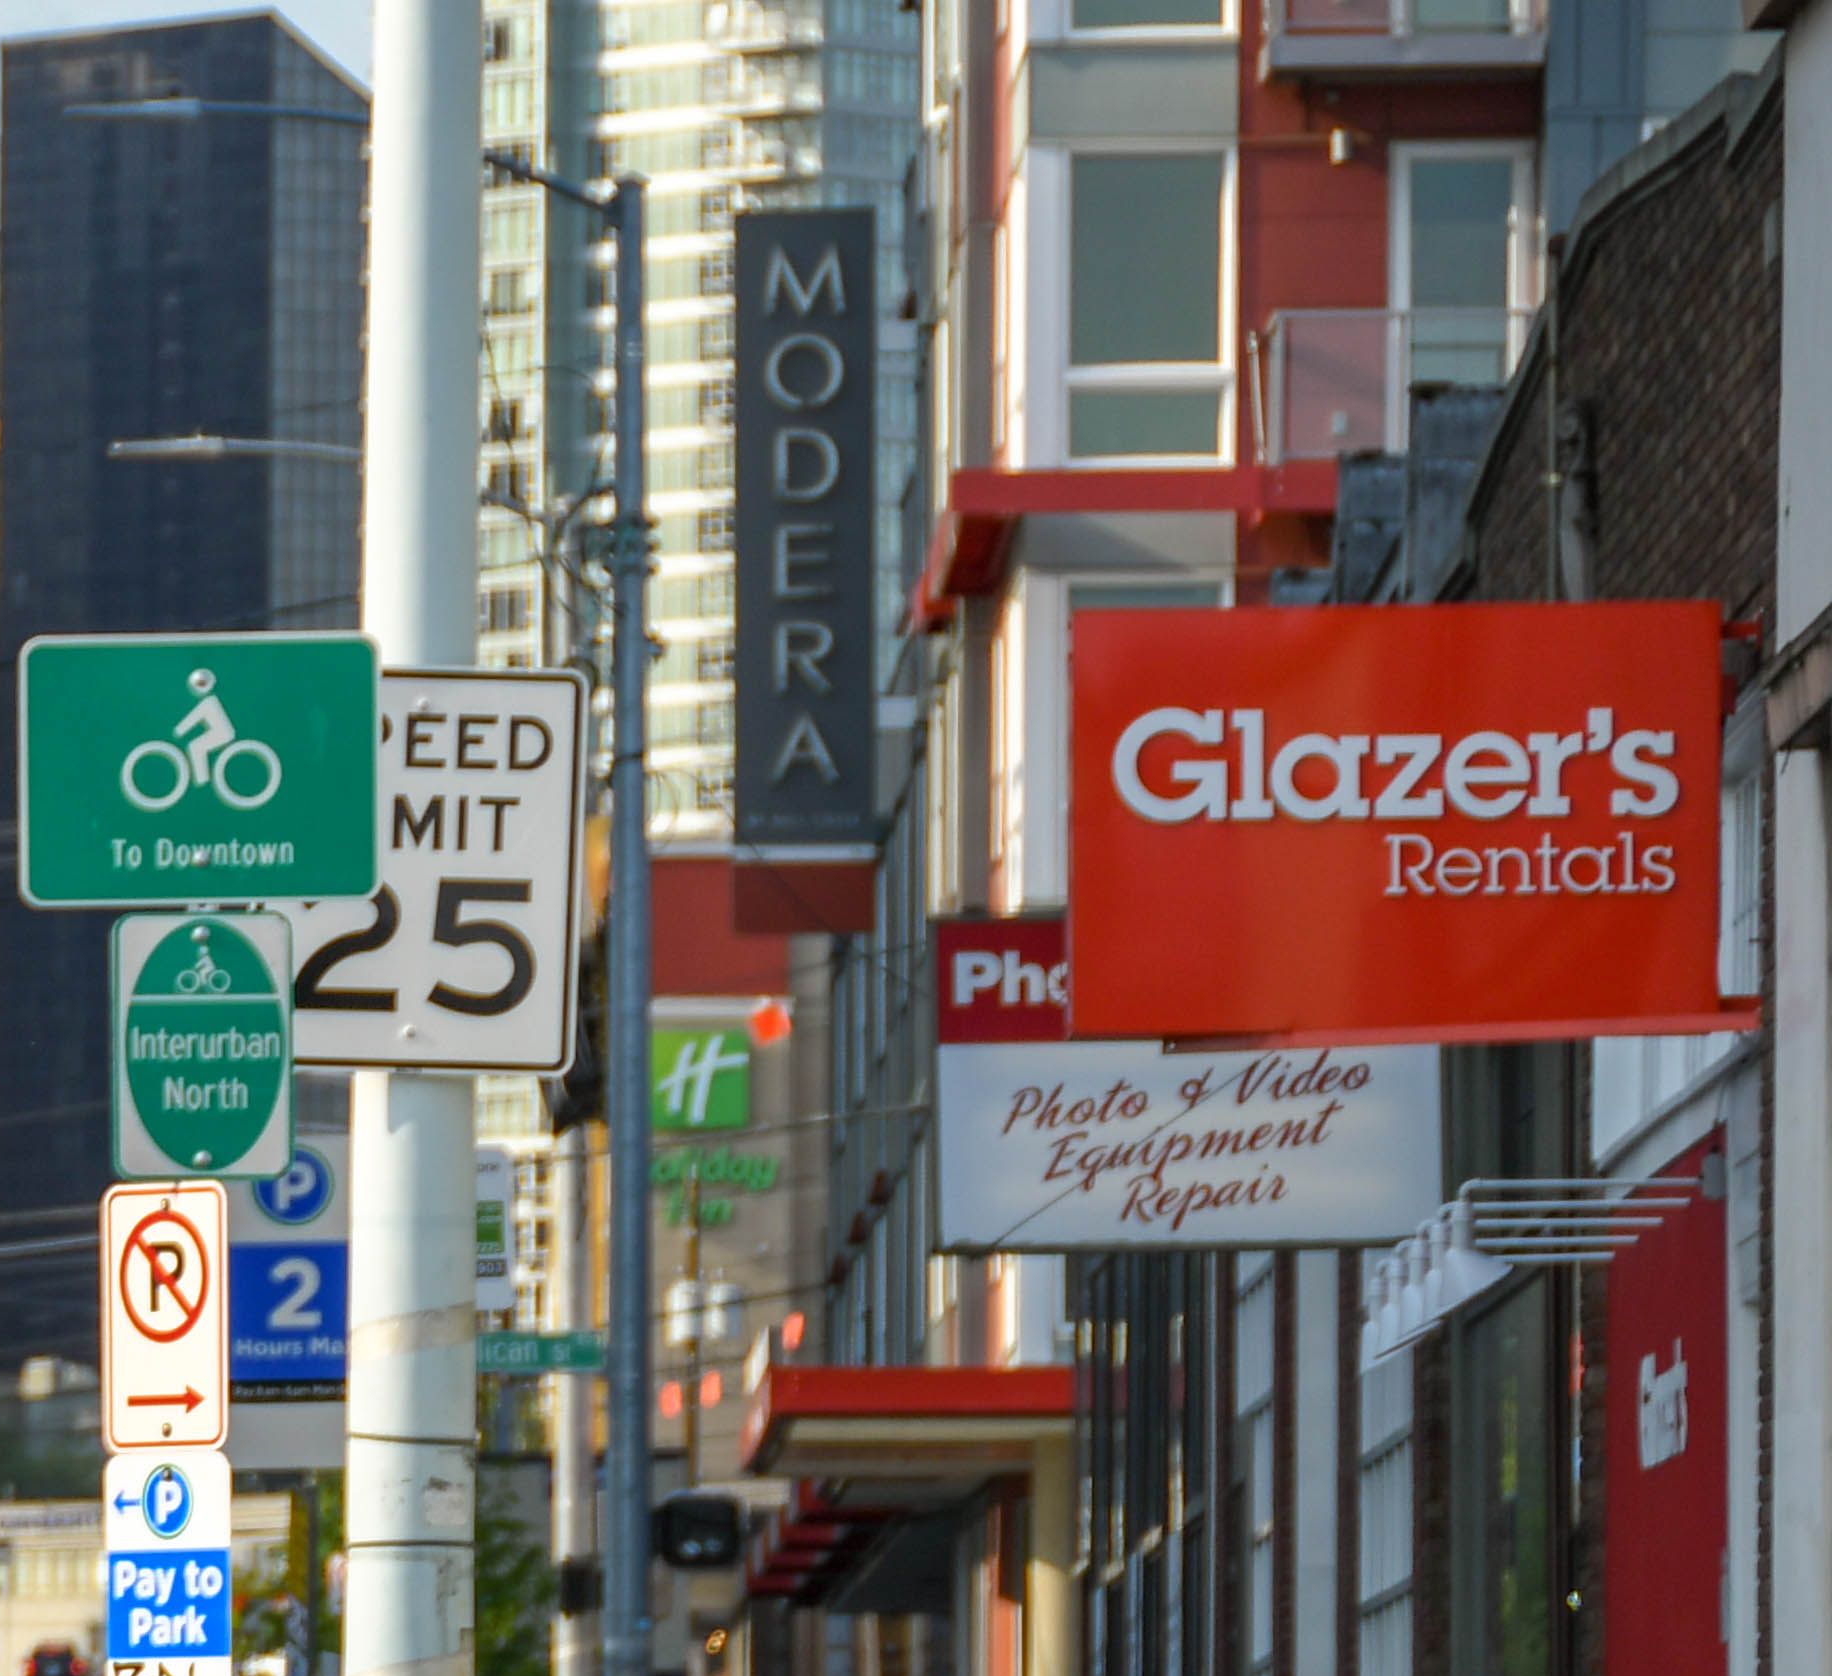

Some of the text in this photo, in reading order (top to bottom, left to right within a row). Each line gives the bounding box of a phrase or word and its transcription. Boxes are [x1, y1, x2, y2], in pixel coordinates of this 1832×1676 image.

[763, 243, 846, 784] MODERA
[382, 712, 554, 770] EED
[1112, 706, 1679, 821] Glazer's
[111, 837, 294, 868] To Downtown
[393, 795, 520, 852] MIT
[1383, 832, 1676, 898] Rentals
[294, 877, 537, 1017] 25
[131, 1026, 281, 1061] Interurban
[163, 1076, 248, 1112] North
[1003, 1078, 1148, 1136] Photo
[1229, 1047, 1371, 1107] Video
[1042, 1098, 1344, 1192] Equipment
[1118, 1164, 1289, 1230] Repair
[267, 1257, 323, 1330] 2
[235, 1335, 347, 1357] Hours Ma
[477, 1336, 540, 1364] lican
[113, 1558, 223, 1606] Pay to
[127, 1605, 209, 1648] Park
